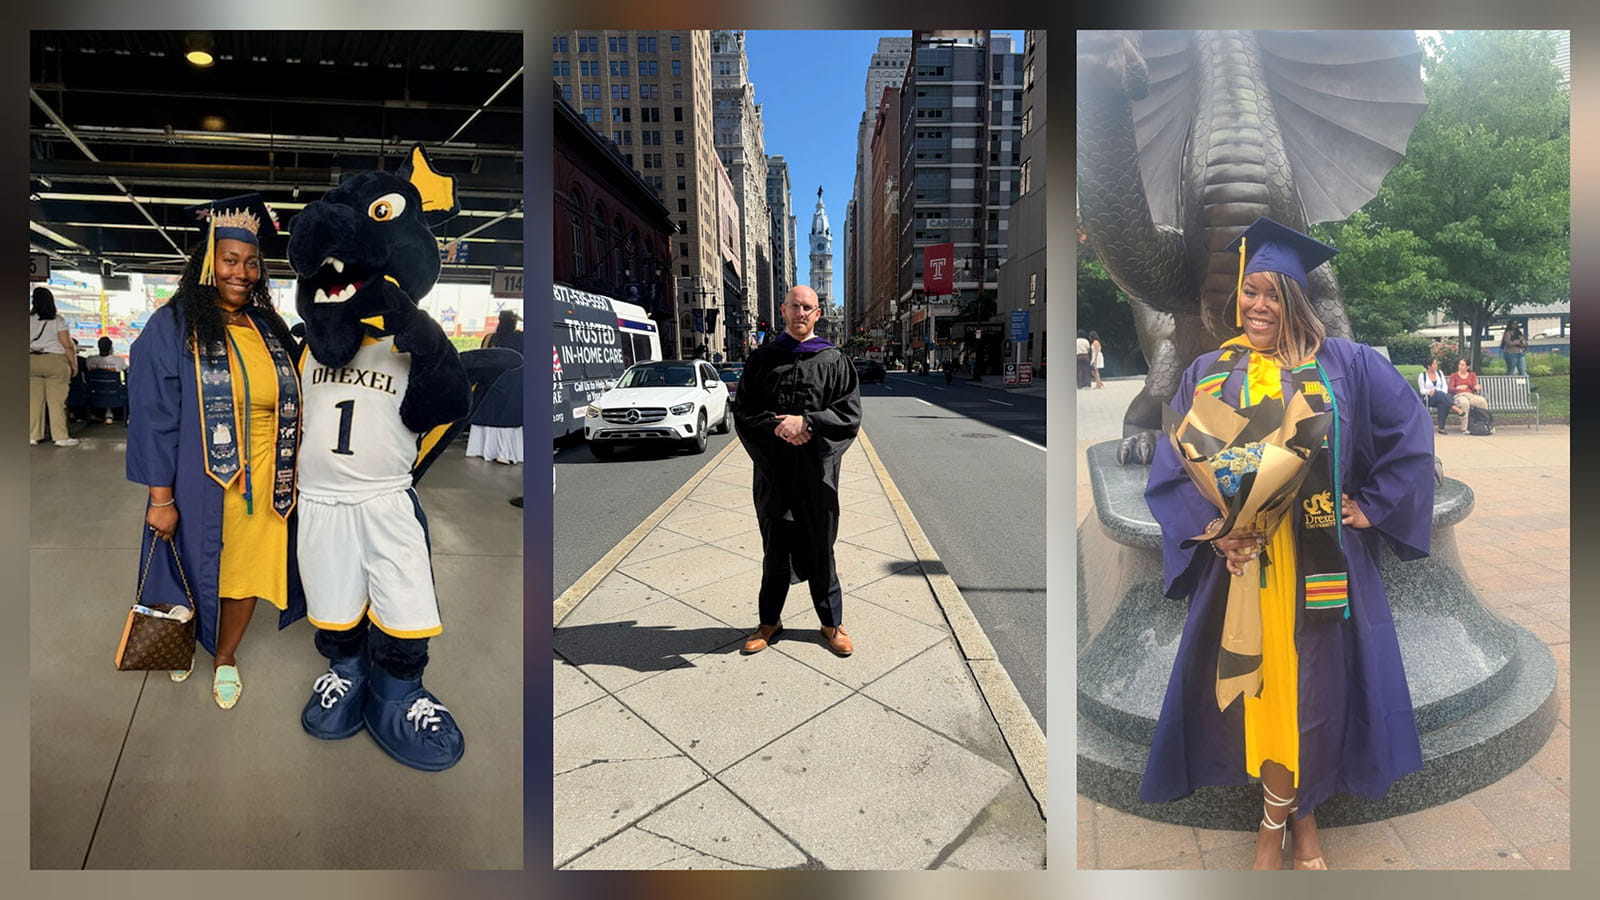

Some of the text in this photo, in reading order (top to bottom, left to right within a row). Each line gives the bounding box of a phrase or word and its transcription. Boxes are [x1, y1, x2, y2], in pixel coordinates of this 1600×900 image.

[504, 275, 523, 291] 114
[564, 319, 615, 345] TRUSTED
[561, 345, 623, 364] IN-HOME CARE
[312, 366, 397, 395] DREXEL
[330, 399, 355, 456] 1
[1304, 511, 1335, 524] Drexel
